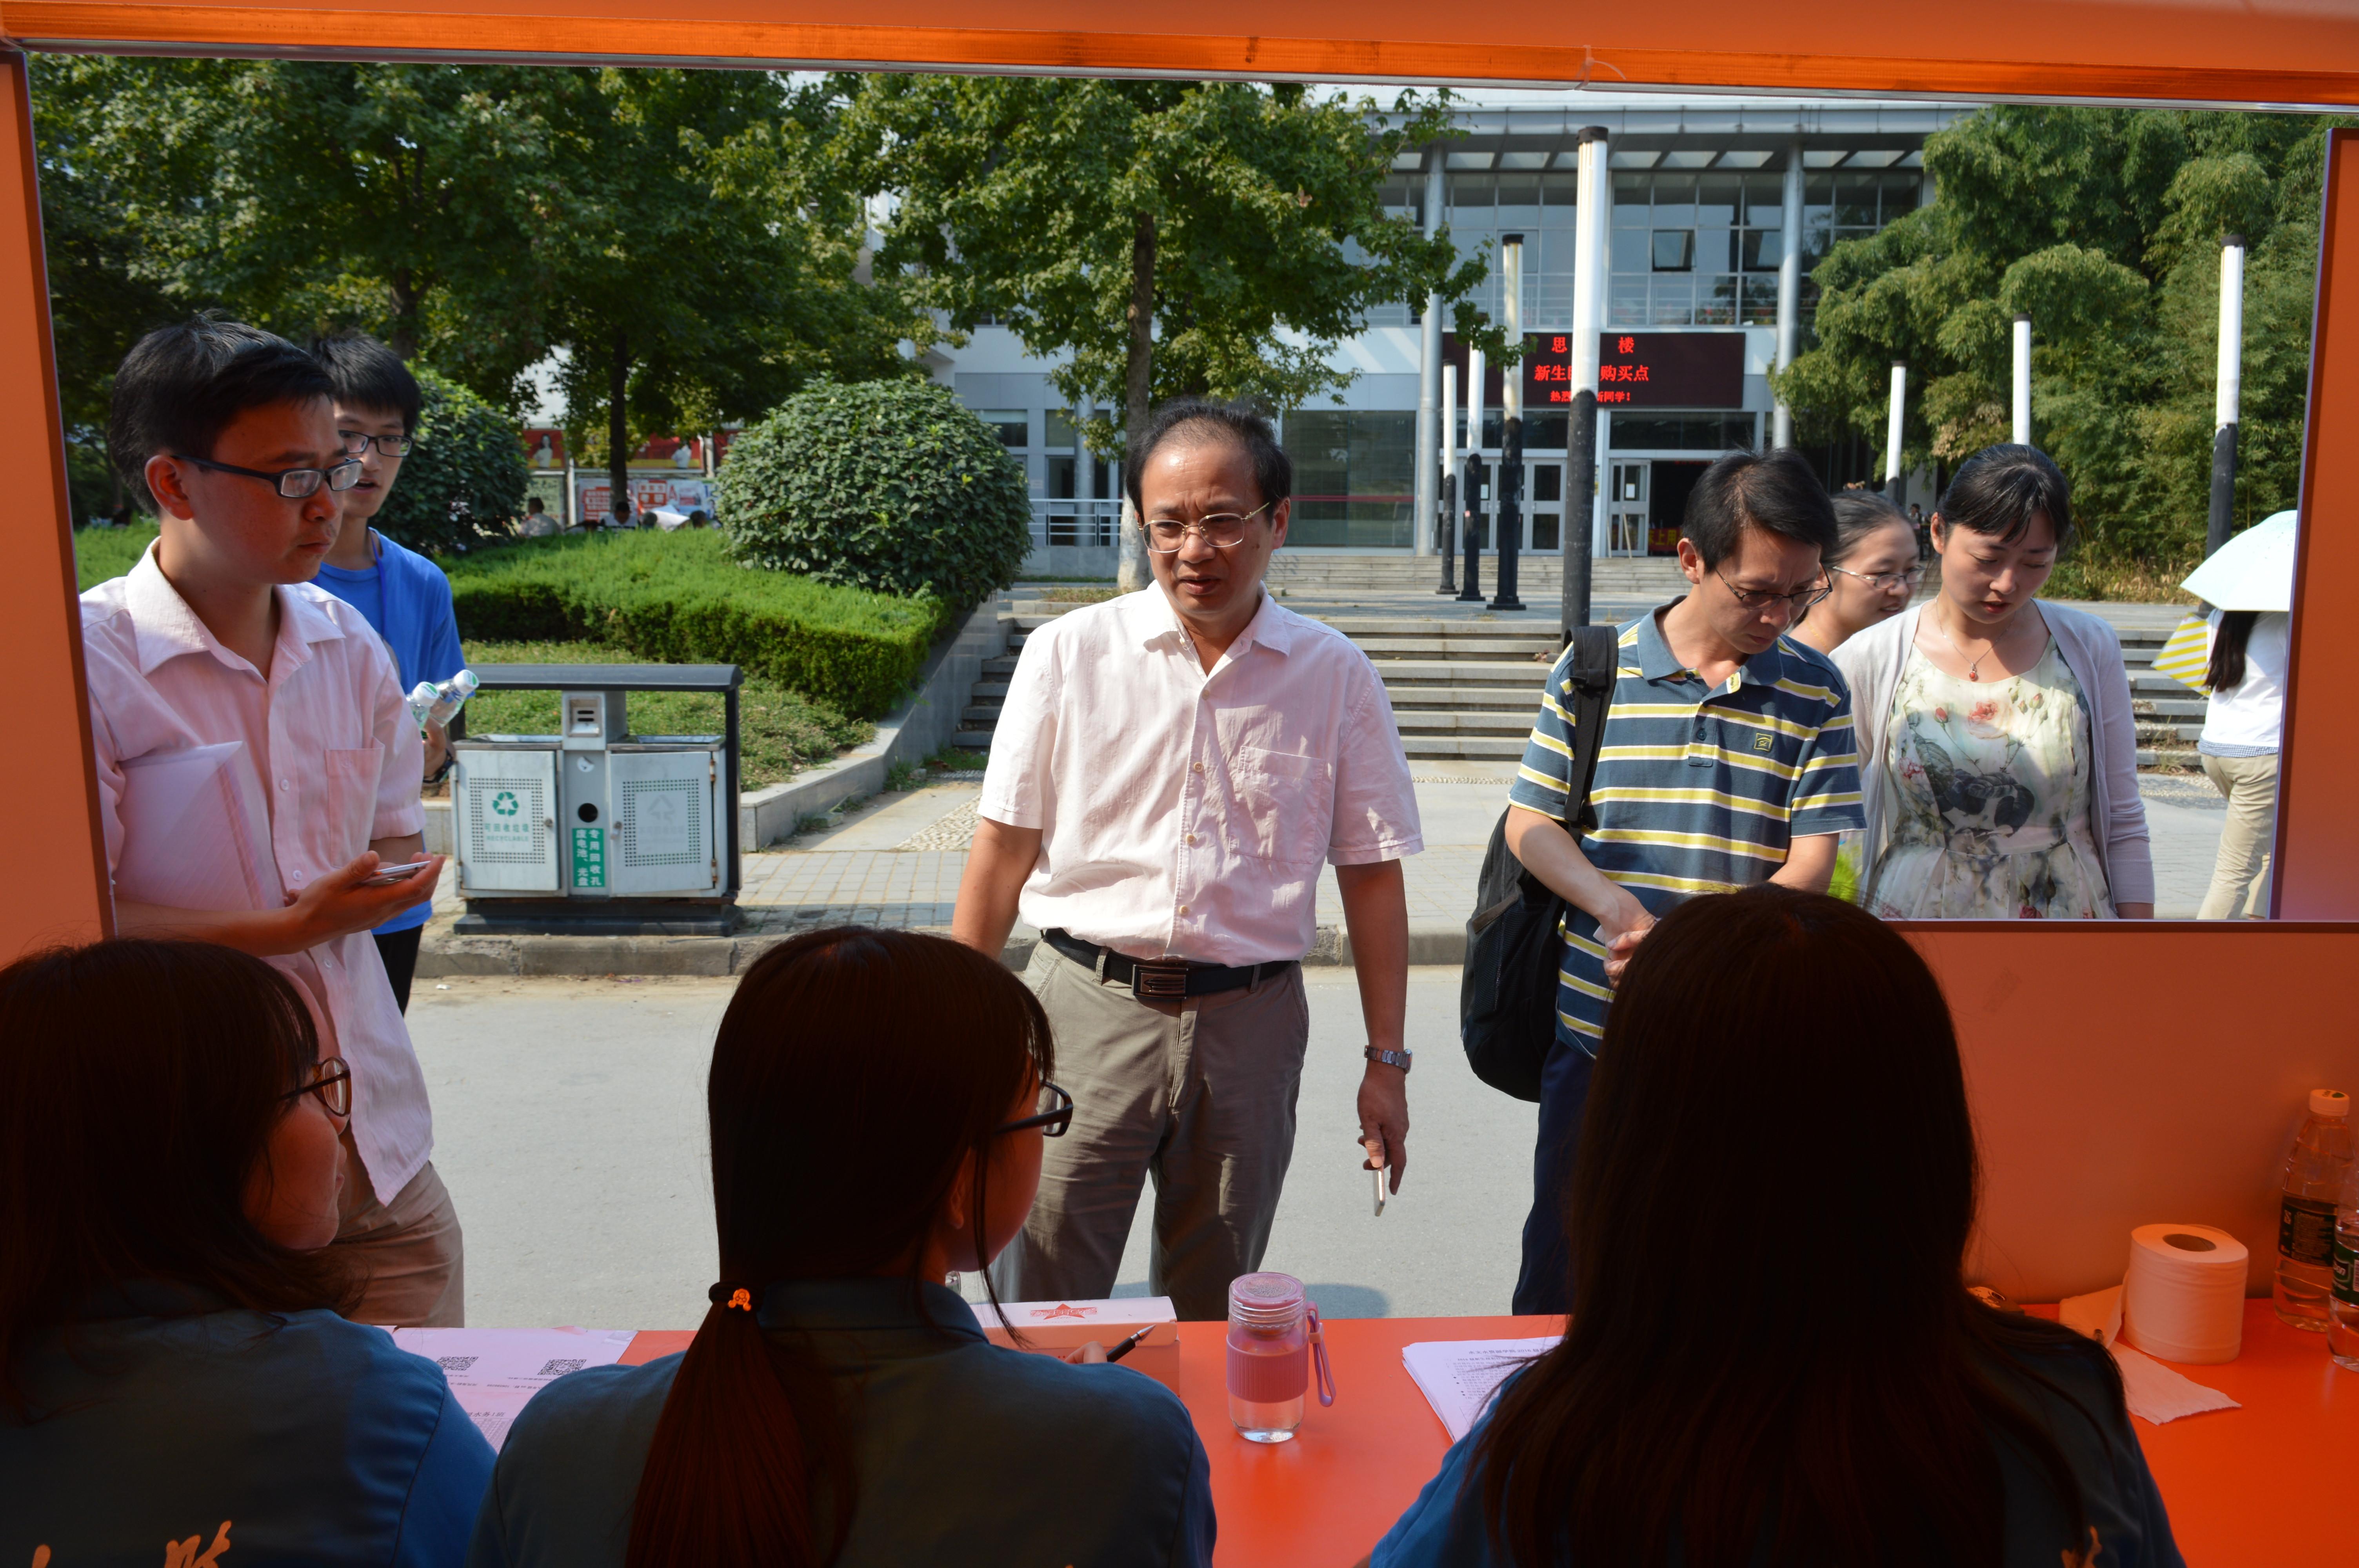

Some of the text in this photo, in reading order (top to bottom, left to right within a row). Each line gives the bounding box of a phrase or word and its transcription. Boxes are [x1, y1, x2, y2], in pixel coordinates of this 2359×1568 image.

[1552, 336, 1635, 354] 思 楼
[1534, 365, 1649, 381] 新生购买点
[484, 823, 529, 833] 可回收垃圾
[589, 829, 602, 886] 专用回收孔
